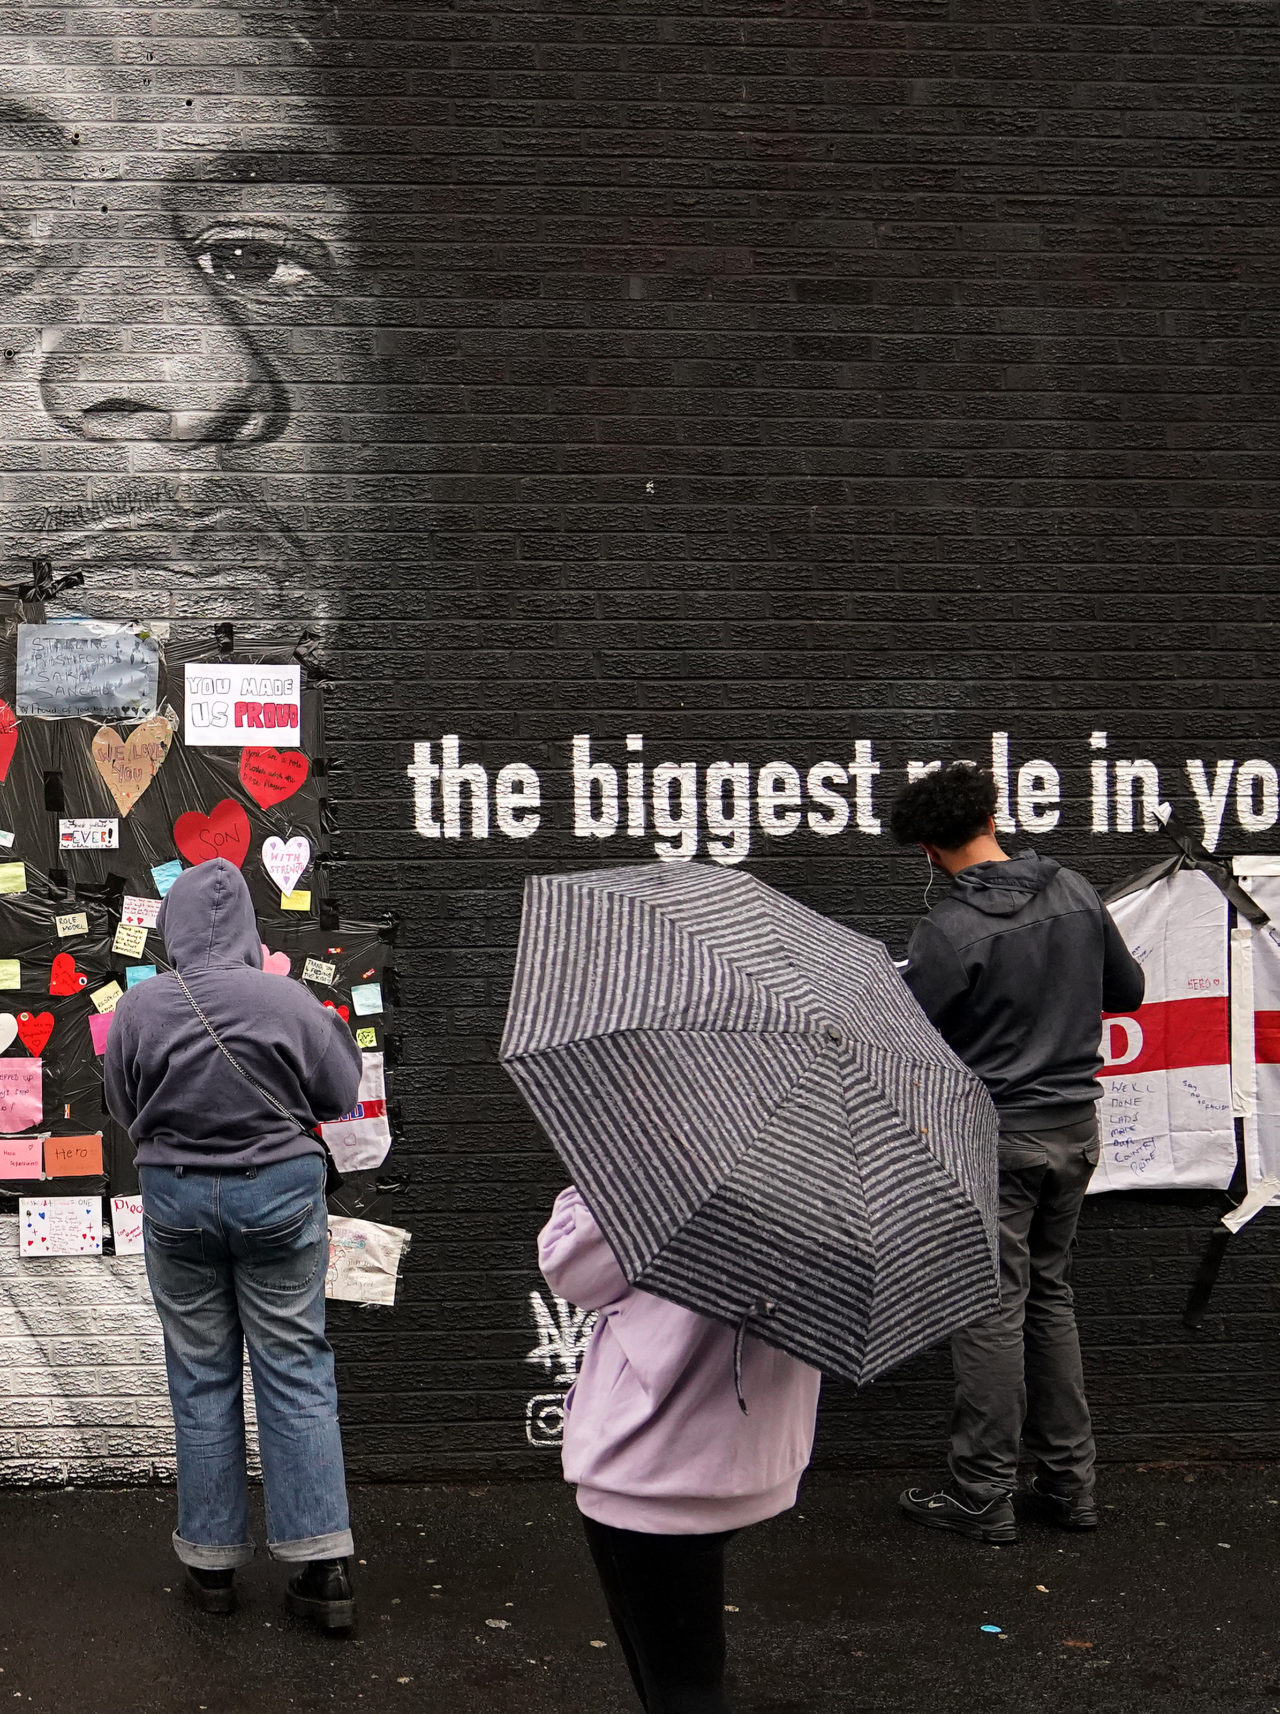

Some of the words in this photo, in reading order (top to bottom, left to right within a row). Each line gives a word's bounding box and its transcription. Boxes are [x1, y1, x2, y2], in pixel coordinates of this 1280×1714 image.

[186, 677, 231, 696] YOU
[240, 678, 293, 696] MADE
[191, 701, 229, 728] US
[234, 701, 299, 728] PROUD
[407, 735, 542, 839] the
[572, 734, 881, 865] biggest
[1090, 731, 1160, 833] in
[1186, 758, 1279, 853] yo
[198, 823, 240, 861] SON
[56, 1148, 88, 1160] Hero
